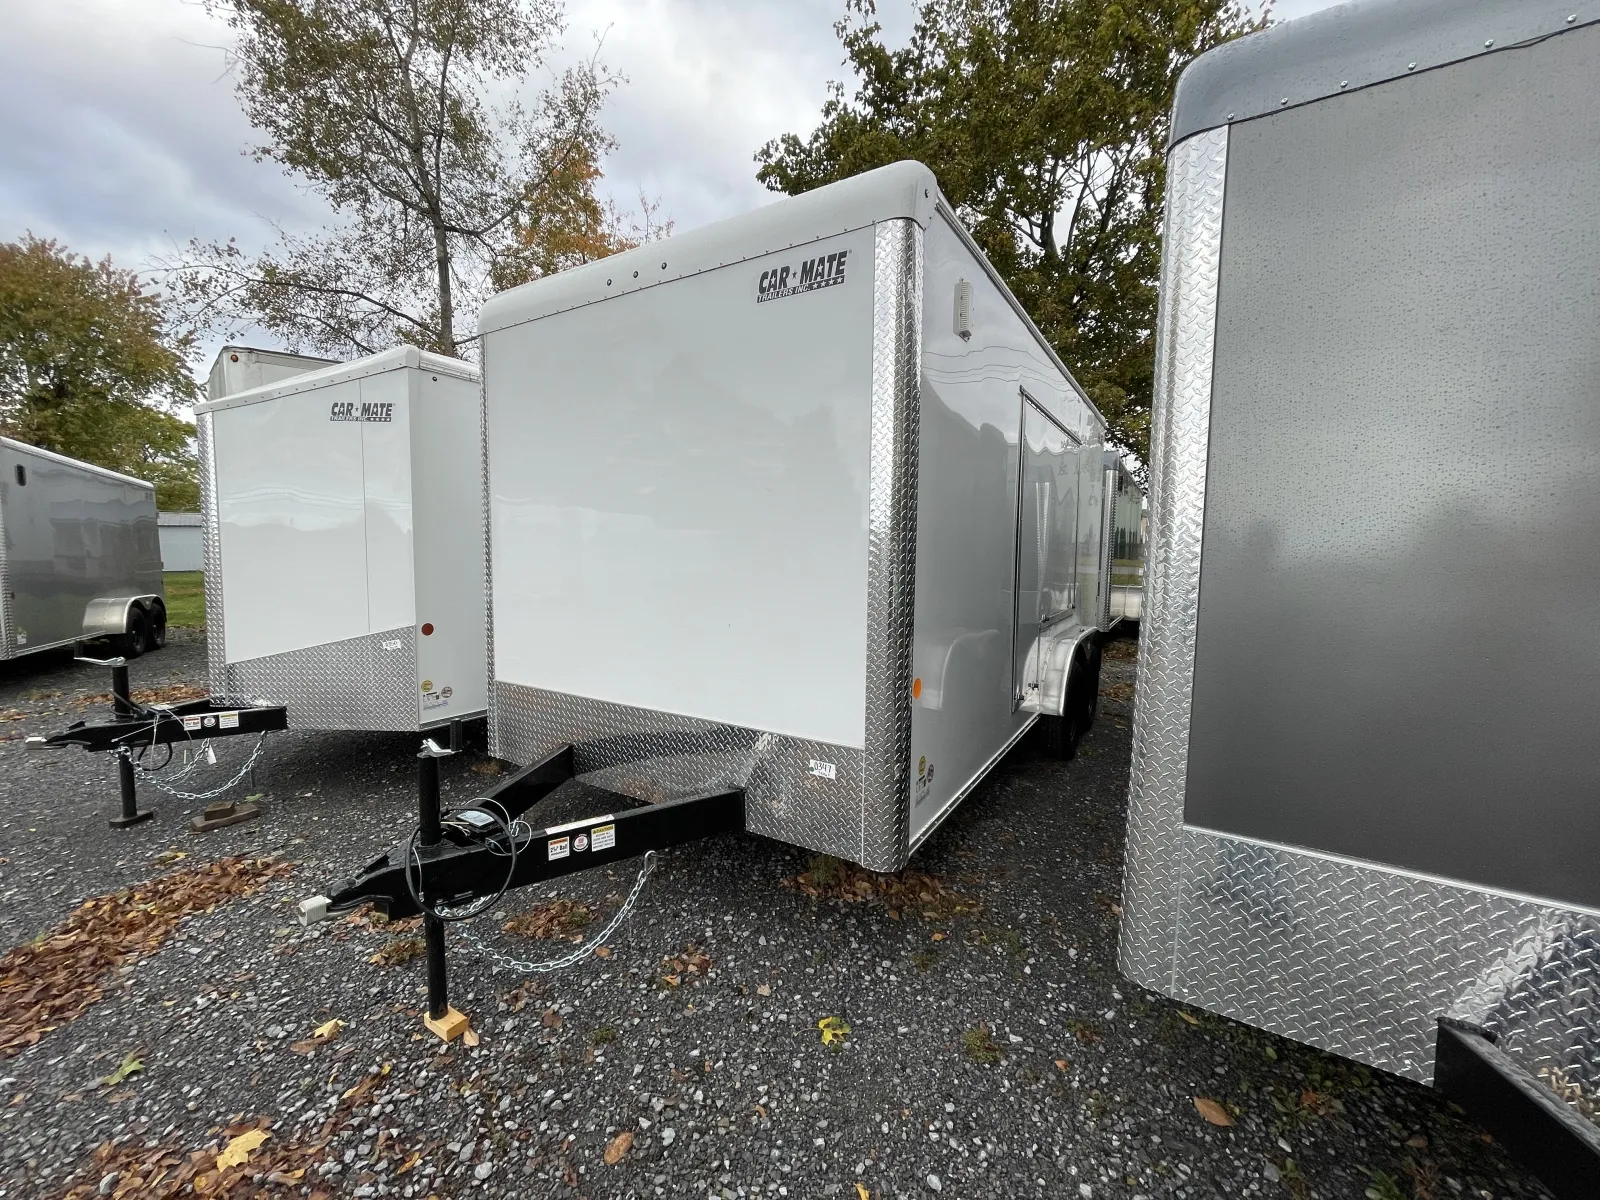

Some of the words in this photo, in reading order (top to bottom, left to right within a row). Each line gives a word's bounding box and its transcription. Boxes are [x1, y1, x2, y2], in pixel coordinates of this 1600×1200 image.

[758, 265, 791, 295] CAR
[800, 250, 848, 285] MATE
[757, 286, 794, 303] TRAILERS
[795, 283, 811, 294] INC.
[331, 402, 354, 417] CAR
[361, 402, 393, 417] MATE
